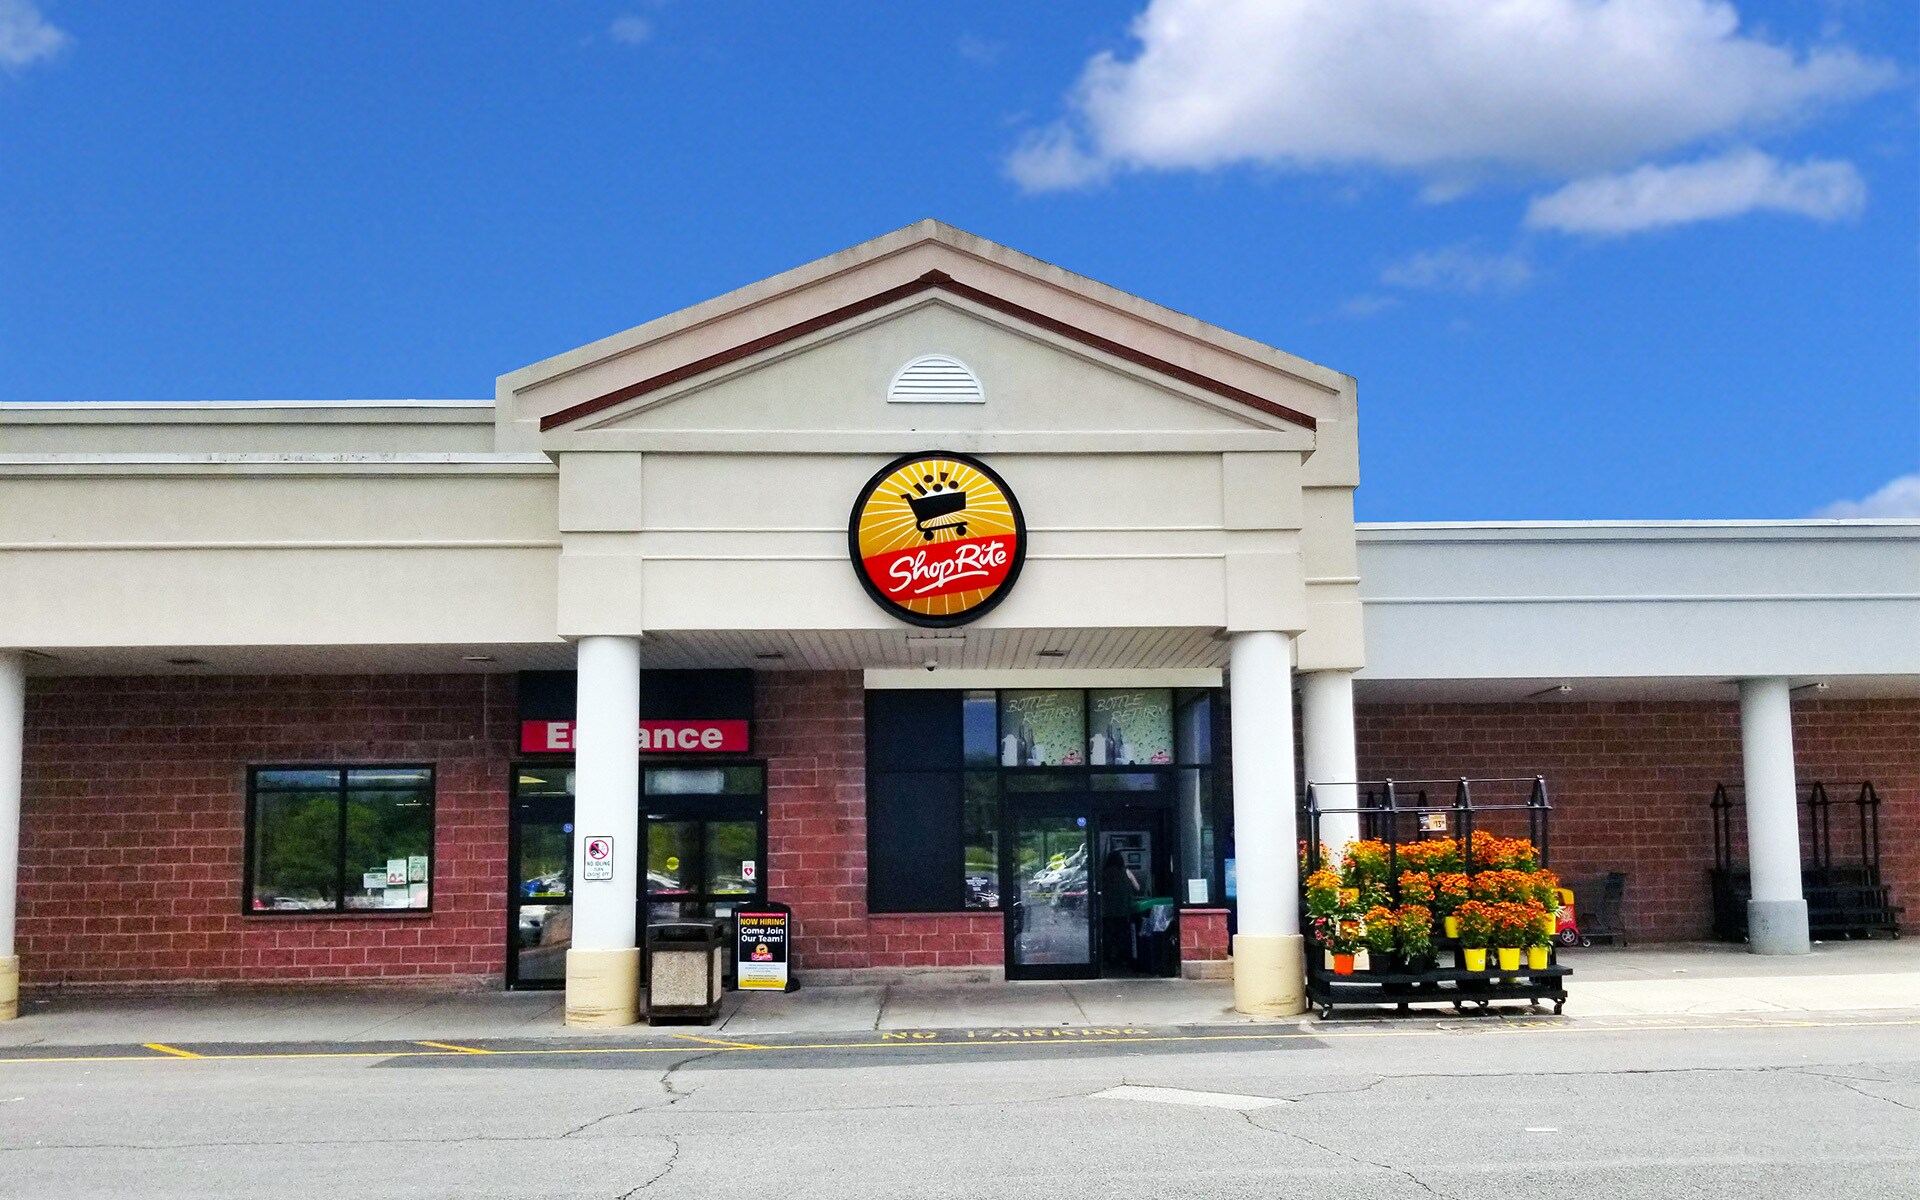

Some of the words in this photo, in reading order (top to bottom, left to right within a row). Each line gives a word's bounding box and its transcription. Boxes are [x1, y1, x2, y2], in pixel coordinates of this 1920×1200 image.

[889, 541, 1006, 593] ShopRite
[1006, 694, 1057, 713] BOTTLE
[1094, 694, 1145, 712] BOTTLE
[1022, 705, 1081, 724] RETURN
[1111, 704, 1168, 724] RETURN
[882, 1031, 937, 1040] NO
[967, 1028, 1149, 1039] PARKING
